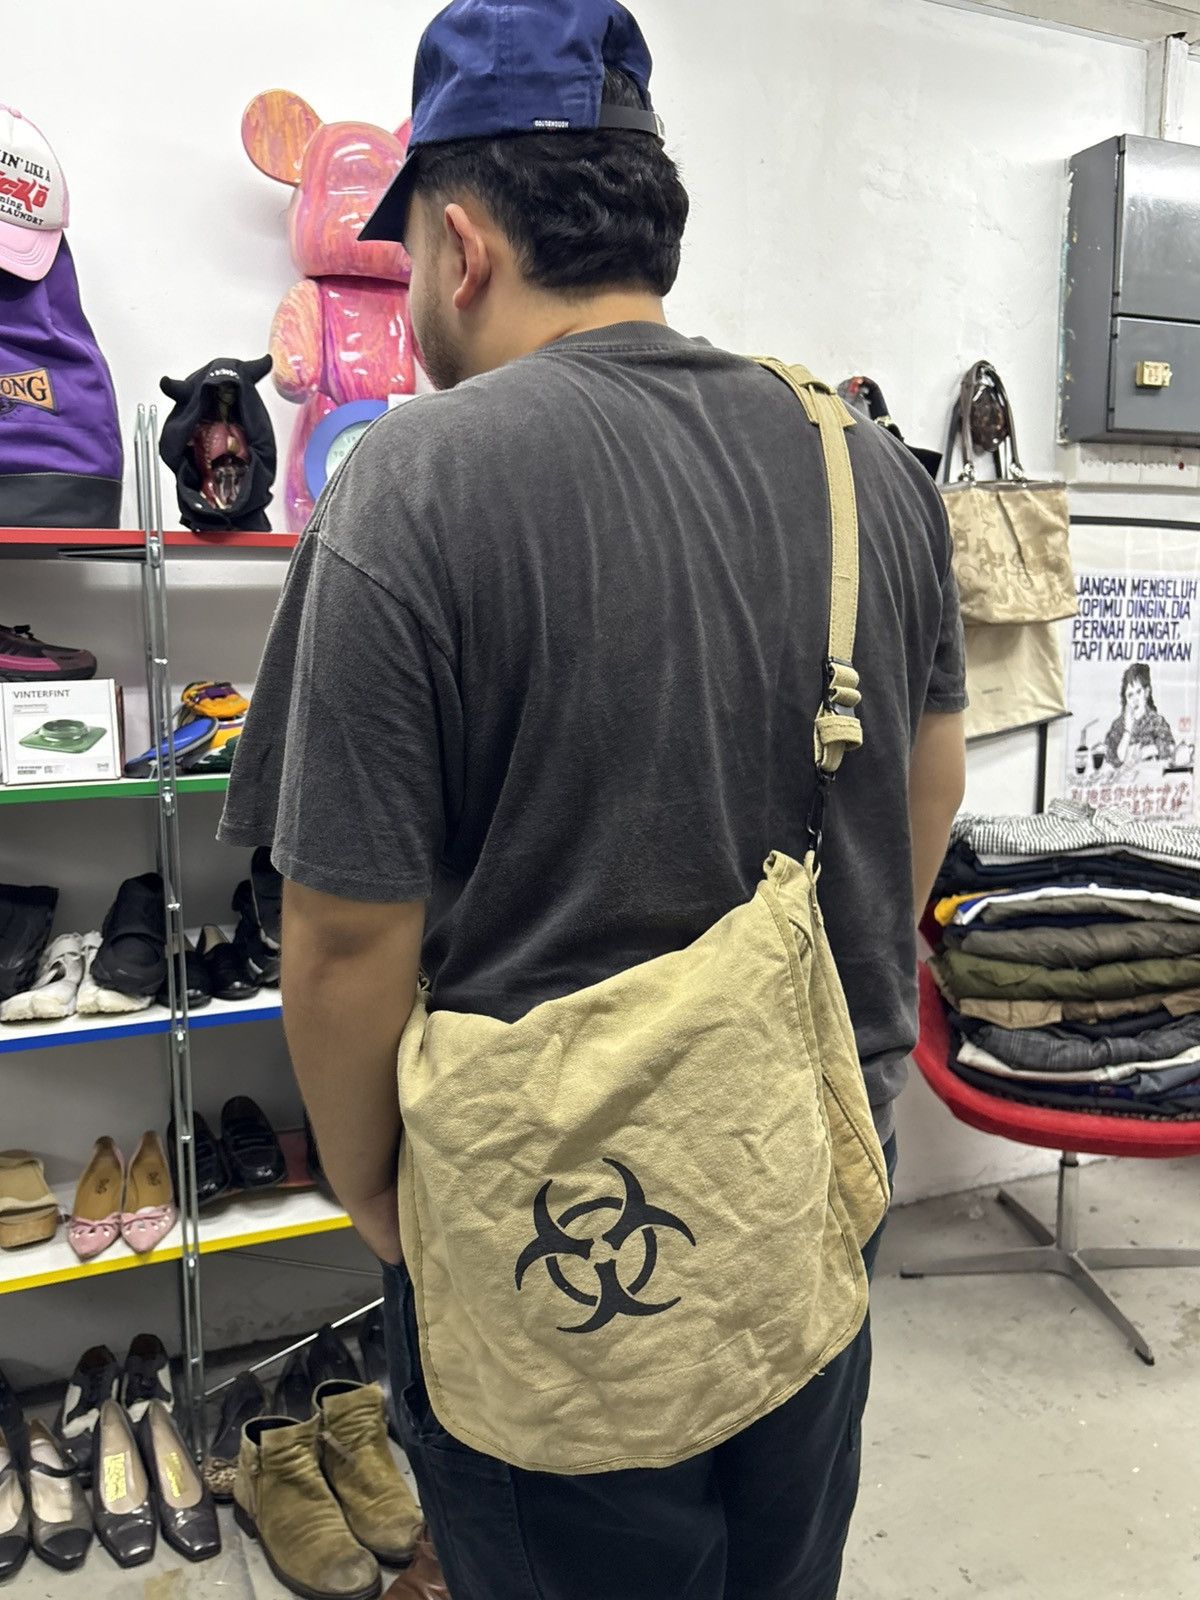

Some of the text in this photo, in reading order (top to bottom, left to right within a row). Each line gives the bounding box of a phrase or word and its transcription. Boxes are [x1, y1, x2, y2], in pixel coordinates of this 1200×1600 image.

[24, 160, 44, 179] LIKE
[45, 169, 51, 182] A
[0, 204, 44, 225] LAUNDRY
[1075, 577, 1198, 600] JANGAN MENGELUH
[1171, 600, 1191, 619] DIA
[1073, 620, 1125, 639] PERNAH
[1072, 641, 1192, 661] TAPI KAU DIAMKAN
[13, 689, 71, 699] VINTERFINT
